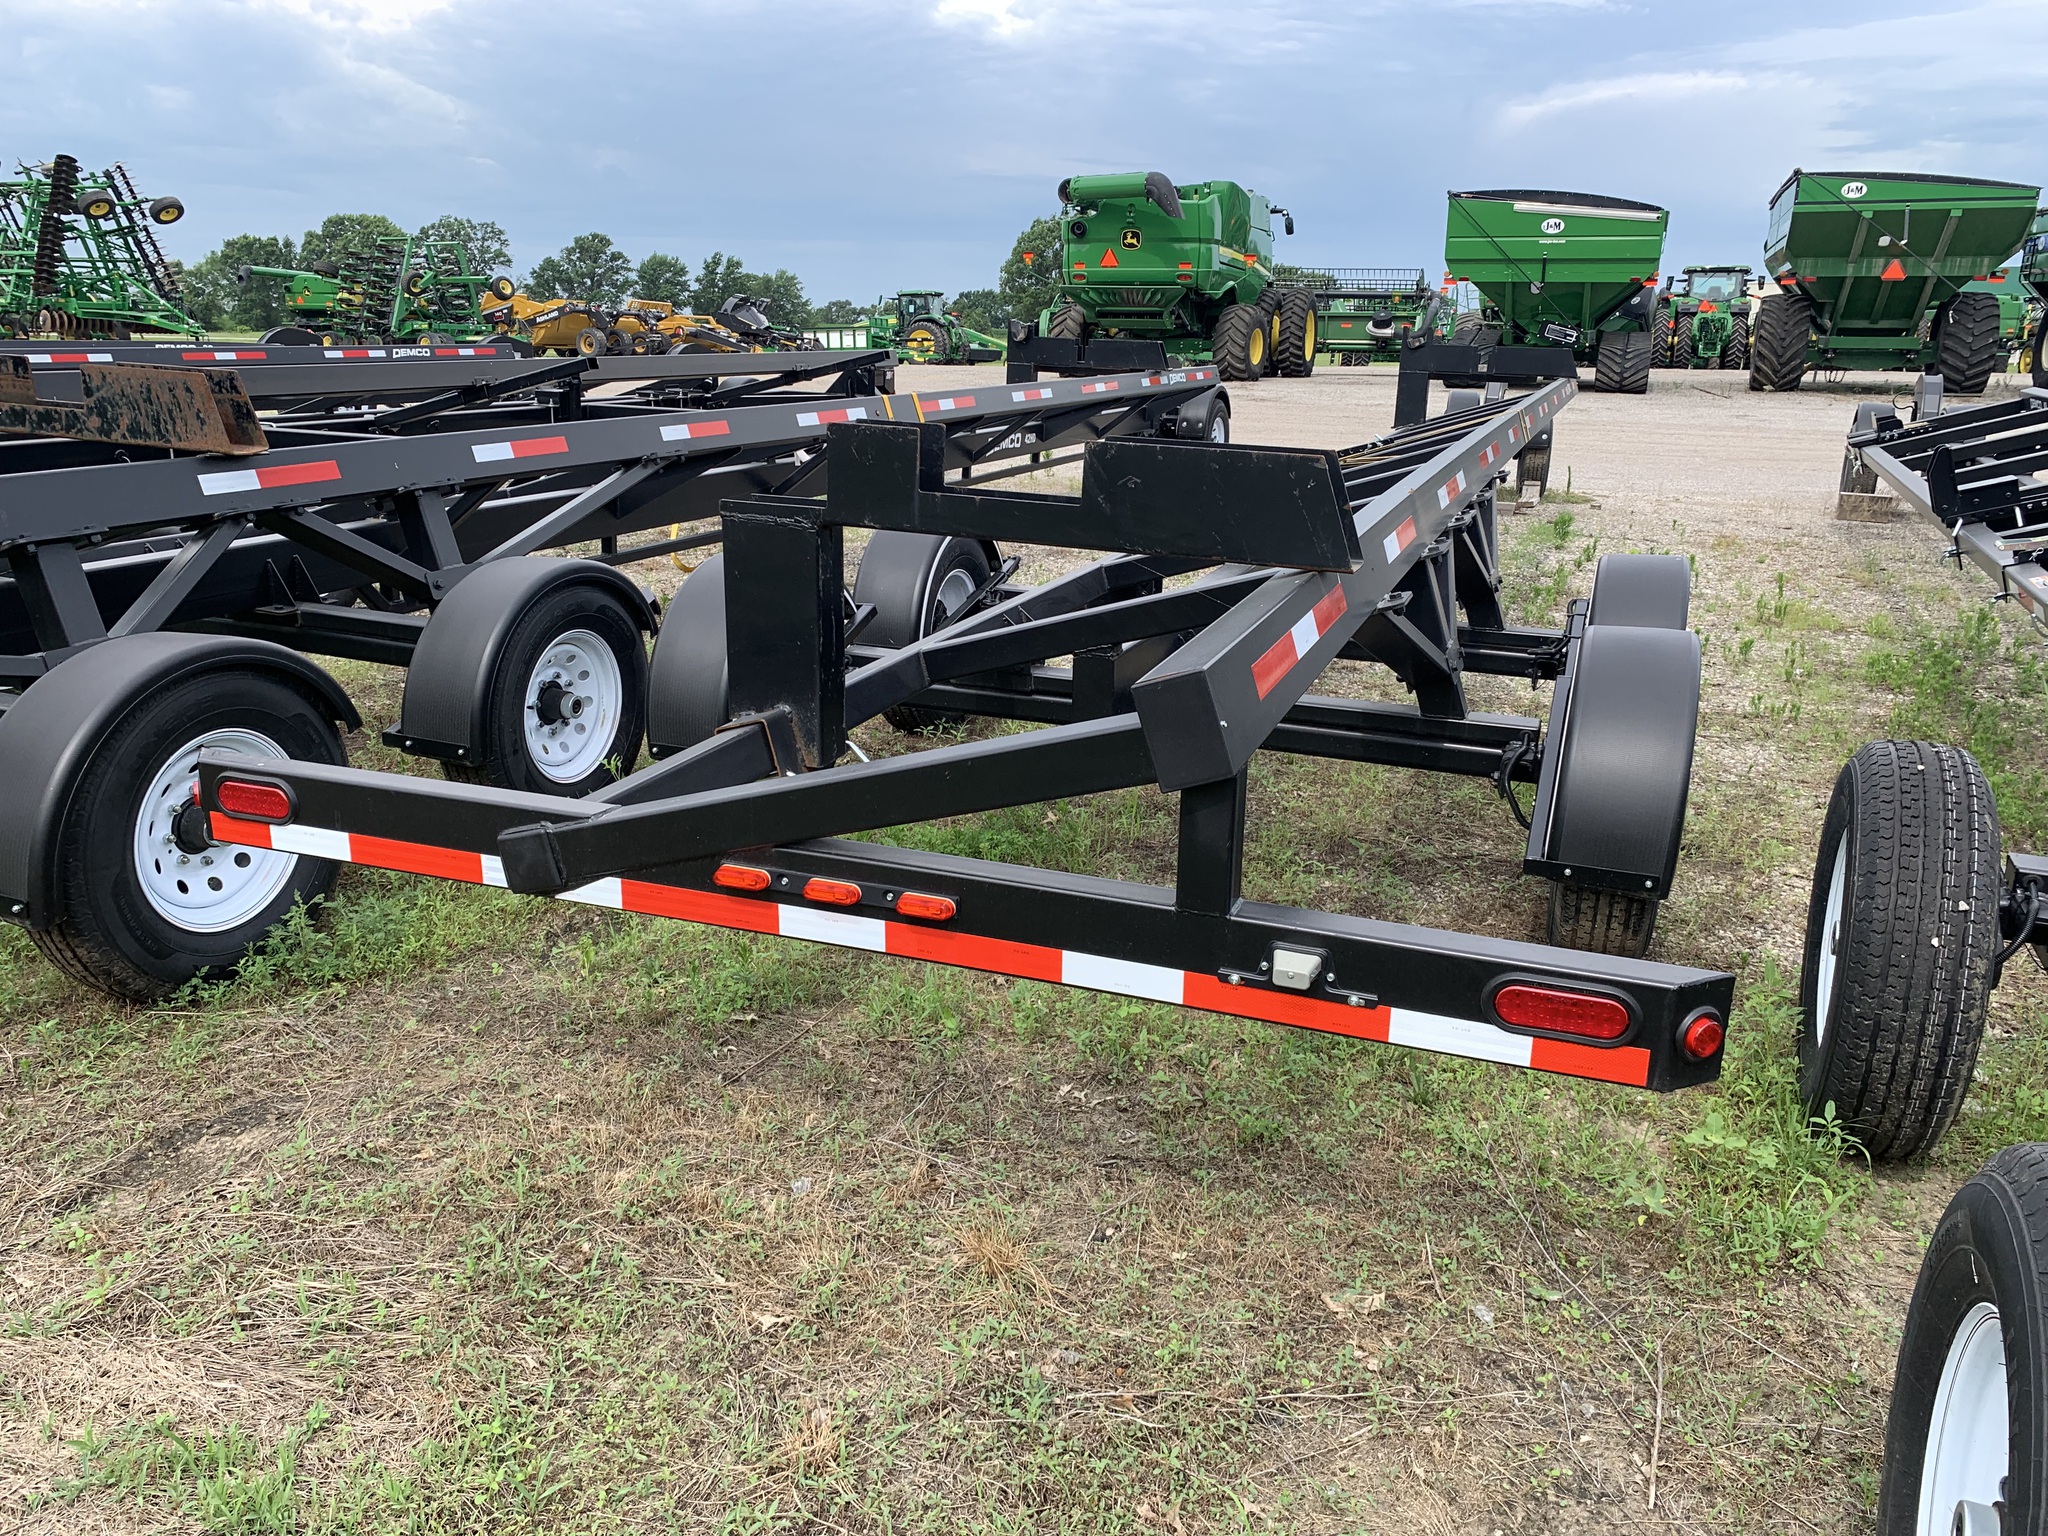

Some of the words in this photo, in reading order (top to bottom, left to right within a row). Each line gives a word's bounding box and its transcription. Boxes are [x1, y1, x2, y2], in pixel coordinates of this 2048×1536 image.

[1843, 185, 1863, 195] J&M
[1543, 221, 1561, 231] J&M
[536, 310, 559, 323] ASHLAND
[392, 348, 431, 358] DEMCO
[1169, 372, 1186, 385] DEMCO
